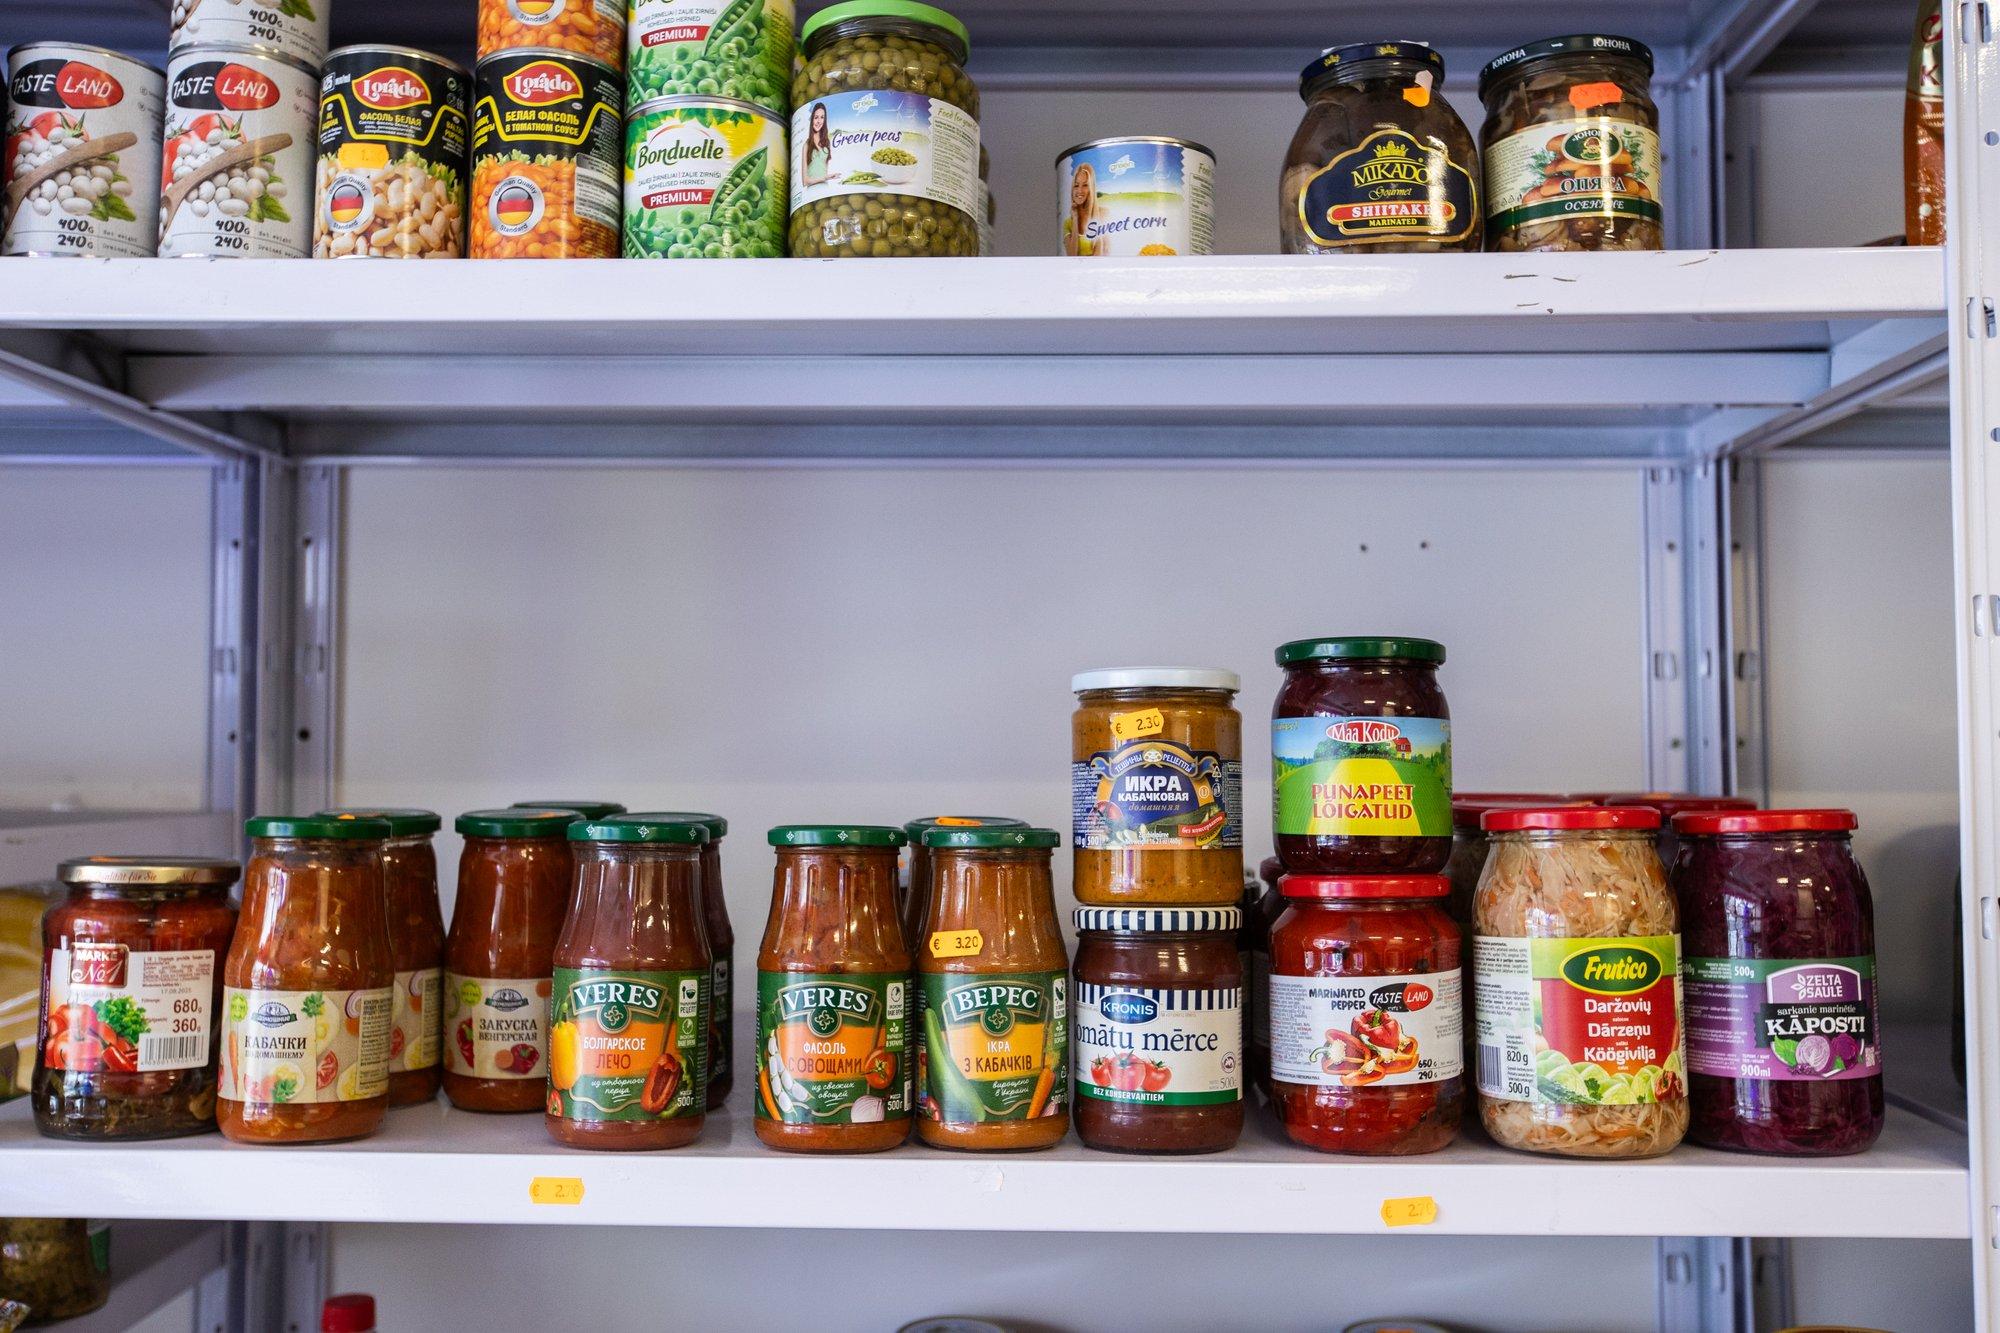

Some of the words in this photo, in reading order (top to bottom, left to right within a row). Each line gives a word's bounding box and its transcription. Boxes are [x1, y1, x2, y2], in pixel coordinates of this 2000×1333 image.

[519, 13, 550, 23] Standard
[648, 28, 698, 45] PREMIUM
[1592, 37, 1632, 52] ЮНОНА
[1492, 48, 1527, 70] ЮНОНА
[13, 73, 56, 95] TASTE
[63, 75, 112, 99] LAND
[171, 76, 215, 99] TASTE
[221, 77, 268, 100] LAND
[362, 77, 422, 102] Lorado
[514, 72, 573, 98] Lorado
[359, 112, 394, 122] ФАСОЛЬ
[394, 115, 423, 126] БЕЛАЯ
[505, 110, 536, 122] БЕЛАЯ
[537, 111, 580, 126] ФАСОЛЬ
[511, 122, 553, 132] ТОМАТНОМ
[554, 124, 579, 136] СОУСЕ
[831, 129, 869, 148] Green
[870, 130, 903, 147] peas
[637, 138, 724, 169] Bonduelle
[1351, 162, 1429, 188] MIKADO
[517, 177, 539, 195] Quality
[1368, 186, 1413, 201] Gourmet
[650, 191, 702, 207] PREMIUM
[499, 223, 529, 235] Standard
[1086, 216, 1130, 239] Sweet
[1133, 215, 1167, 229] corn
[1368, 217, 1418, 228] MARINATED
[1115, 722, 1123, 736] €
[1136, 715, 1161, 731] 2.30
[1331, 723, 1360, 742] Maa
[1362, 721, 1395, 743] Kodu
[1114, 754, 1143, 774] ТЕШИНЫ
[1163, 753, 1193, 774] РЕЦЕПТЫ
[1125, 775, 1182, 792] ИКРА
[1118, 792, 1189, 802] КАБАЧКОВАЯ
[1311, 783, 1414, 803] PUNAPEET
[1128, 801, 1180, 811] домашняя
[1312, 800, 1414, 820] LÕIGATUD
[1181, 825, 1191, 834] без
[933, 938, 941, 951] €
[955, 936, 979, 950] 3.20
[76, 950, 118, 962] MARKE
[1584, 955, 1648, 981] Frutico
[1734, 965, 1755, 979] 500g
[1806, 974, 1842, 986] ZELTA
[573, 982, 660, 1009] VERES
[955, 985, 1038, 1013] ВЕРЕС
[1372, 992, 1403, 1004] TASTE
[1406, 990, 1429, 1003] LAND
[1806, 985, 1843, 998] SAULE
[782, 987, 869, 1013] VERES
[1331, 999, 1366, 1011] PEPPER
[1583, 997, 1652, 1016] Daržovių
[1102, 1001, 1155, 1016] KRONIS
[1777, 1005, 1818, 1016] sarkanie
[1819, 1003, 1857, 1014] marinētie
[479, 1018, 538, 1031] ЗАКУСКА
[1588, 1022, 1651, 1040] Dārzeņu
[1765, 1012, 1866, 1037] KĀPOSTI
[583, 1036, 646, 1051] БОЛГАРСКОЕ
[986, 1040, 1011, 1053] ІКРА
[1143, 1027, 1219, 1052] mērce
[803, 1041, 847, 1055] ФАСОЛЬ
[1583, 1045, 1656, 1066] Köögivilja
[596, 1054, 632, 1070] ЛЕЧО
[975, 1055, 1033, 1073] КАБАЧКІВ
[1506, 1050, 1522, 1062] 820
[1522, 1053, 1529, 1066] g
[796, 1058, 863, 1076] ОВОЩАМИ
[1741, 1064, 1771, 1077] 900ml
[1093, 1086, 1105, 1097] BEZ
[1105, 1089, 1165, 1102] KONSERVANTIEM
[1508, 1081, 1523, 1095] 500
[1524, 1085, 1530, 1098] g
